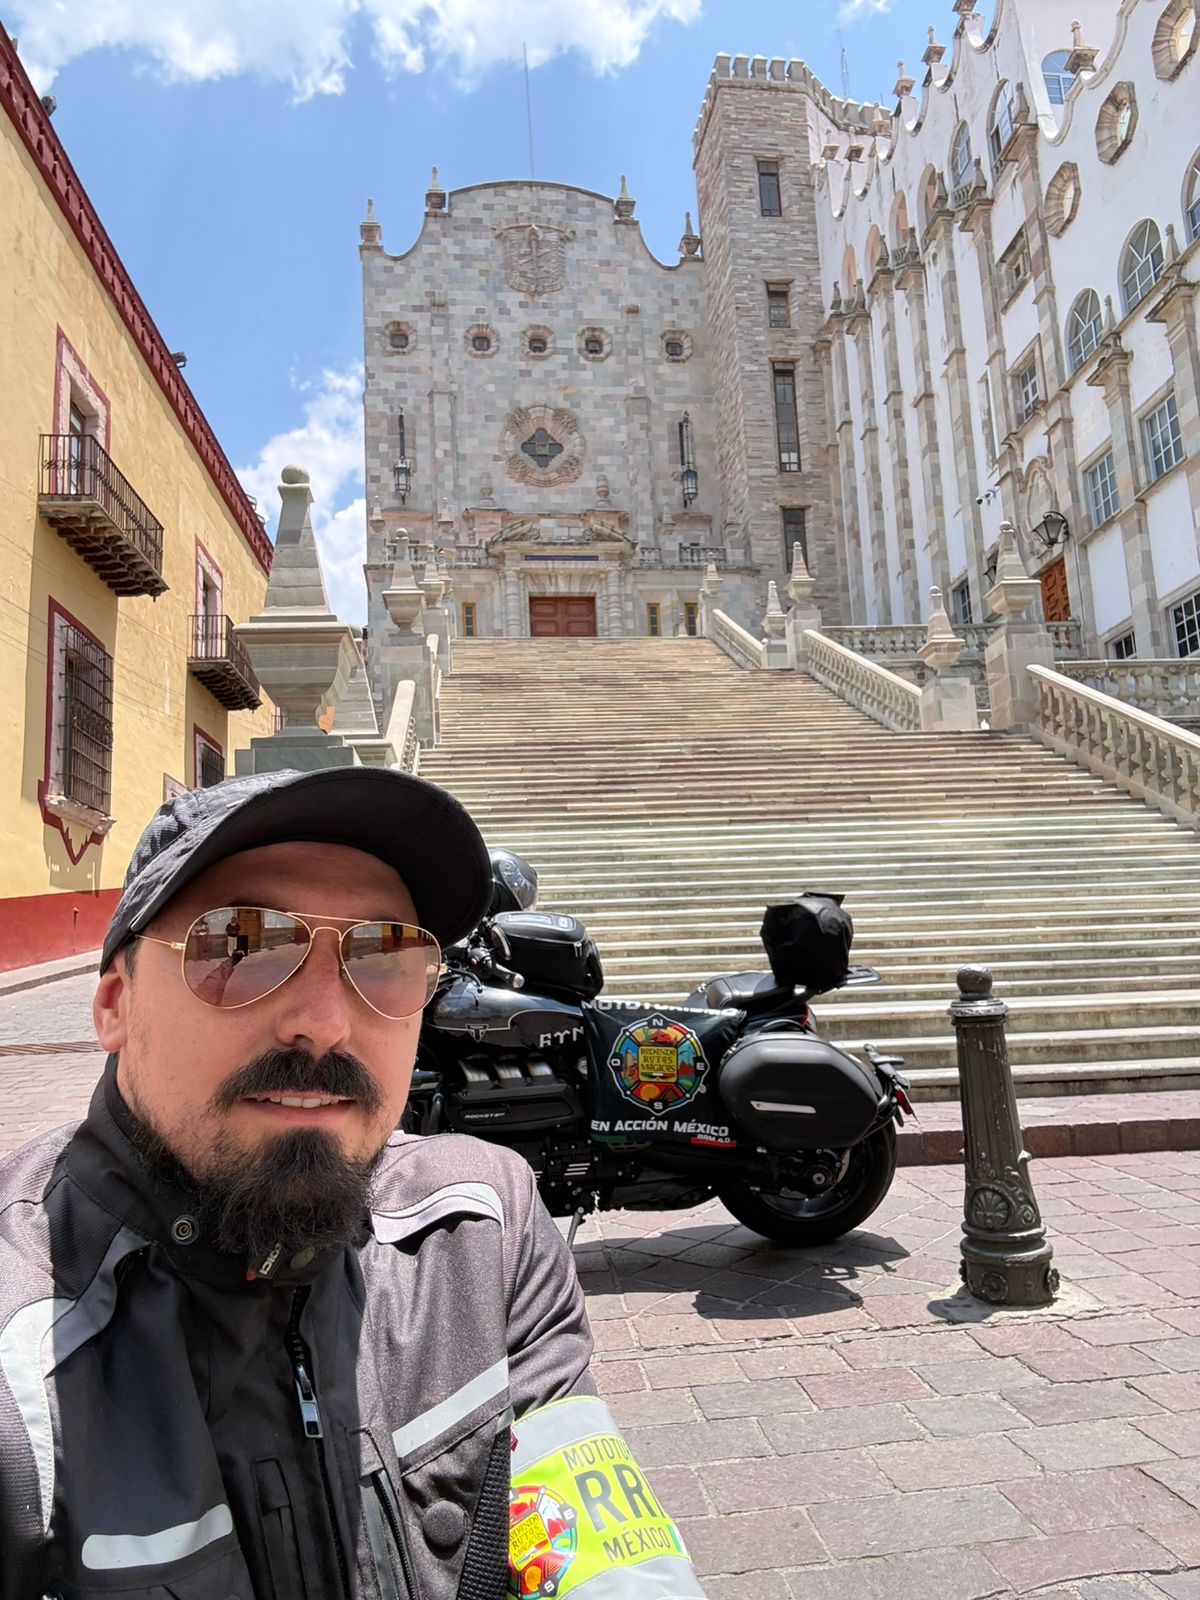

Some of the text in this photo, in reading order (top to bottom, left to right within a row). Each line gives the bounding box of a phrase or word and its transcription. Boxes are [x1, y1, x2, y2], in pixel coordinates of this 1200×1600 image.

[652, 1018, 664, 1026] N
[696, 1062, 705, 1070] E
[653, 1102, 663, 1110] S
[590, 1117, 730, 1137] EN ACCIÓN MÉXICO
[562, 1438, 632, 1472] MOTOTU
[574, 1463, 666, 1533] RR
[602, 1526, 671, 1562] MÉXICO
[544, 1580, 555, 1593] S
